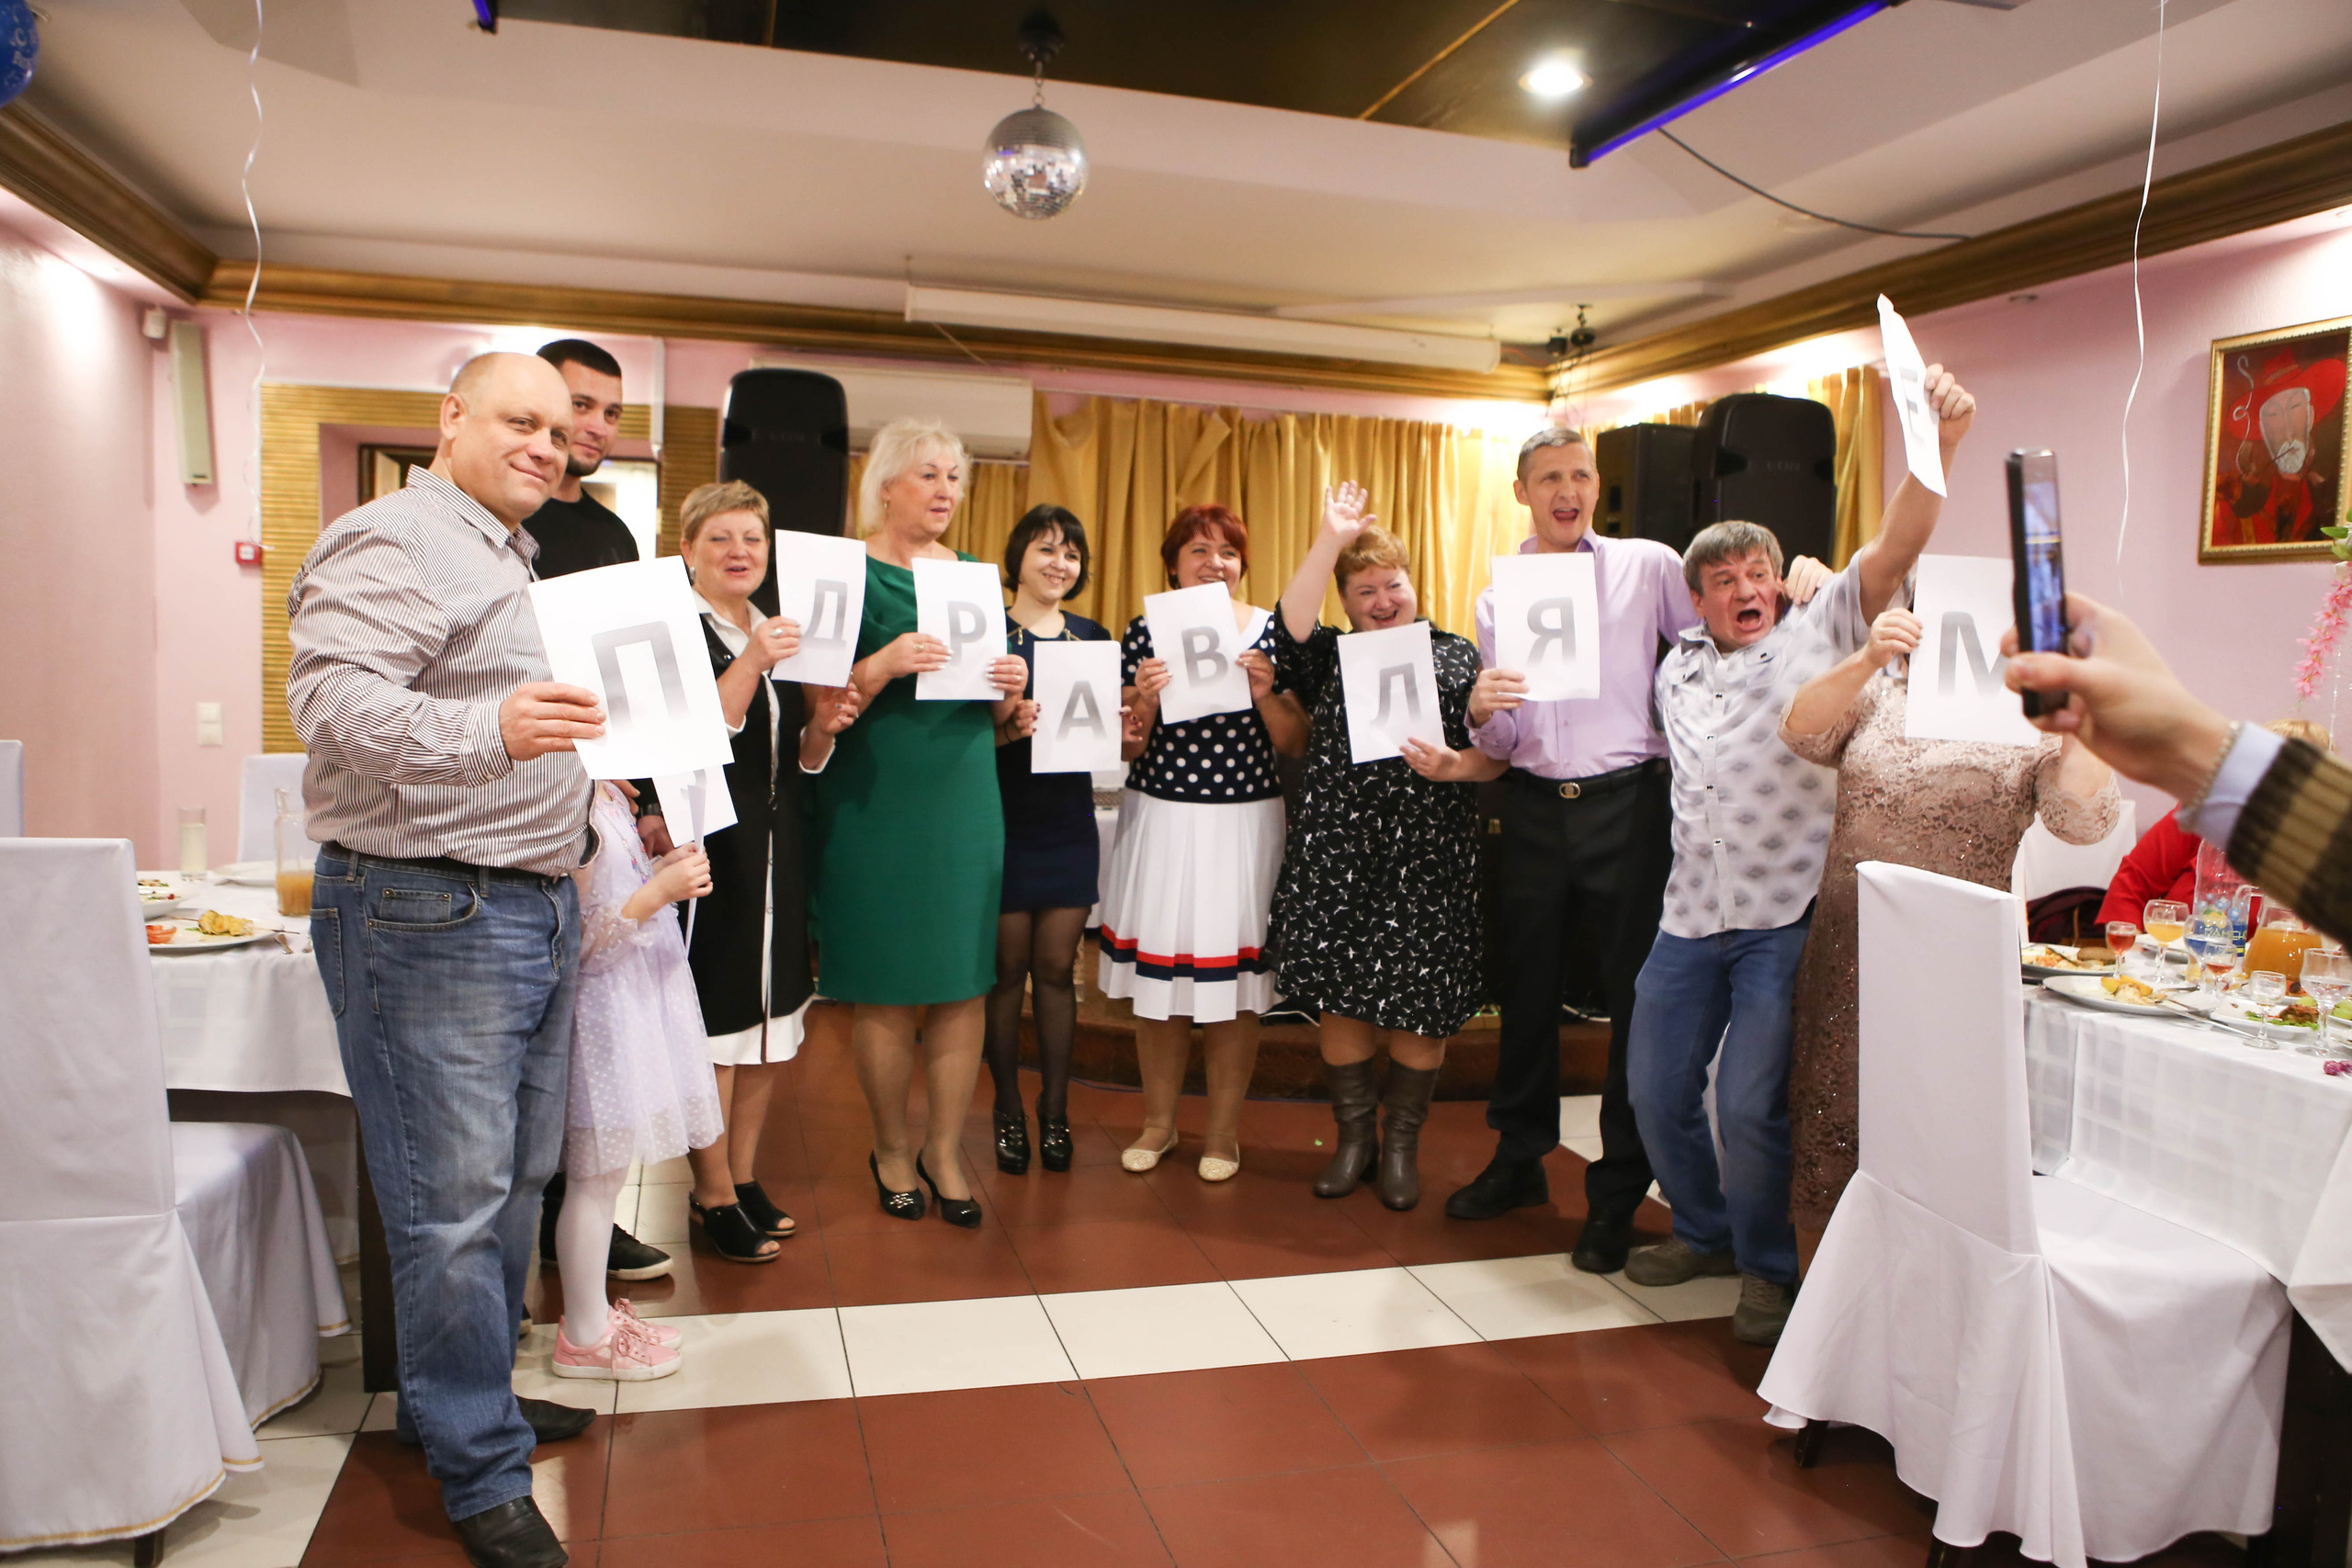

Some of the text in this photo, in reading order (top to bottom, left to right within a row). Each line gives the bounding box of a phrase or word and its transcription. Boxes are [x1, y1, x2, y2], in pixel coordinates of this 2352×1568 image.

[798, 579, 847, 649] Д
[947, 600, 988, 669] Р
[1526, 596, 1577, 667] Я
[591, 620, 691, 734] П
[1181, 625, 1229, 689] В
[1938, 611, 2007, 697] М
[1055, 680, 1108, 742] А
[1369, 661, 1422, 725] Л
